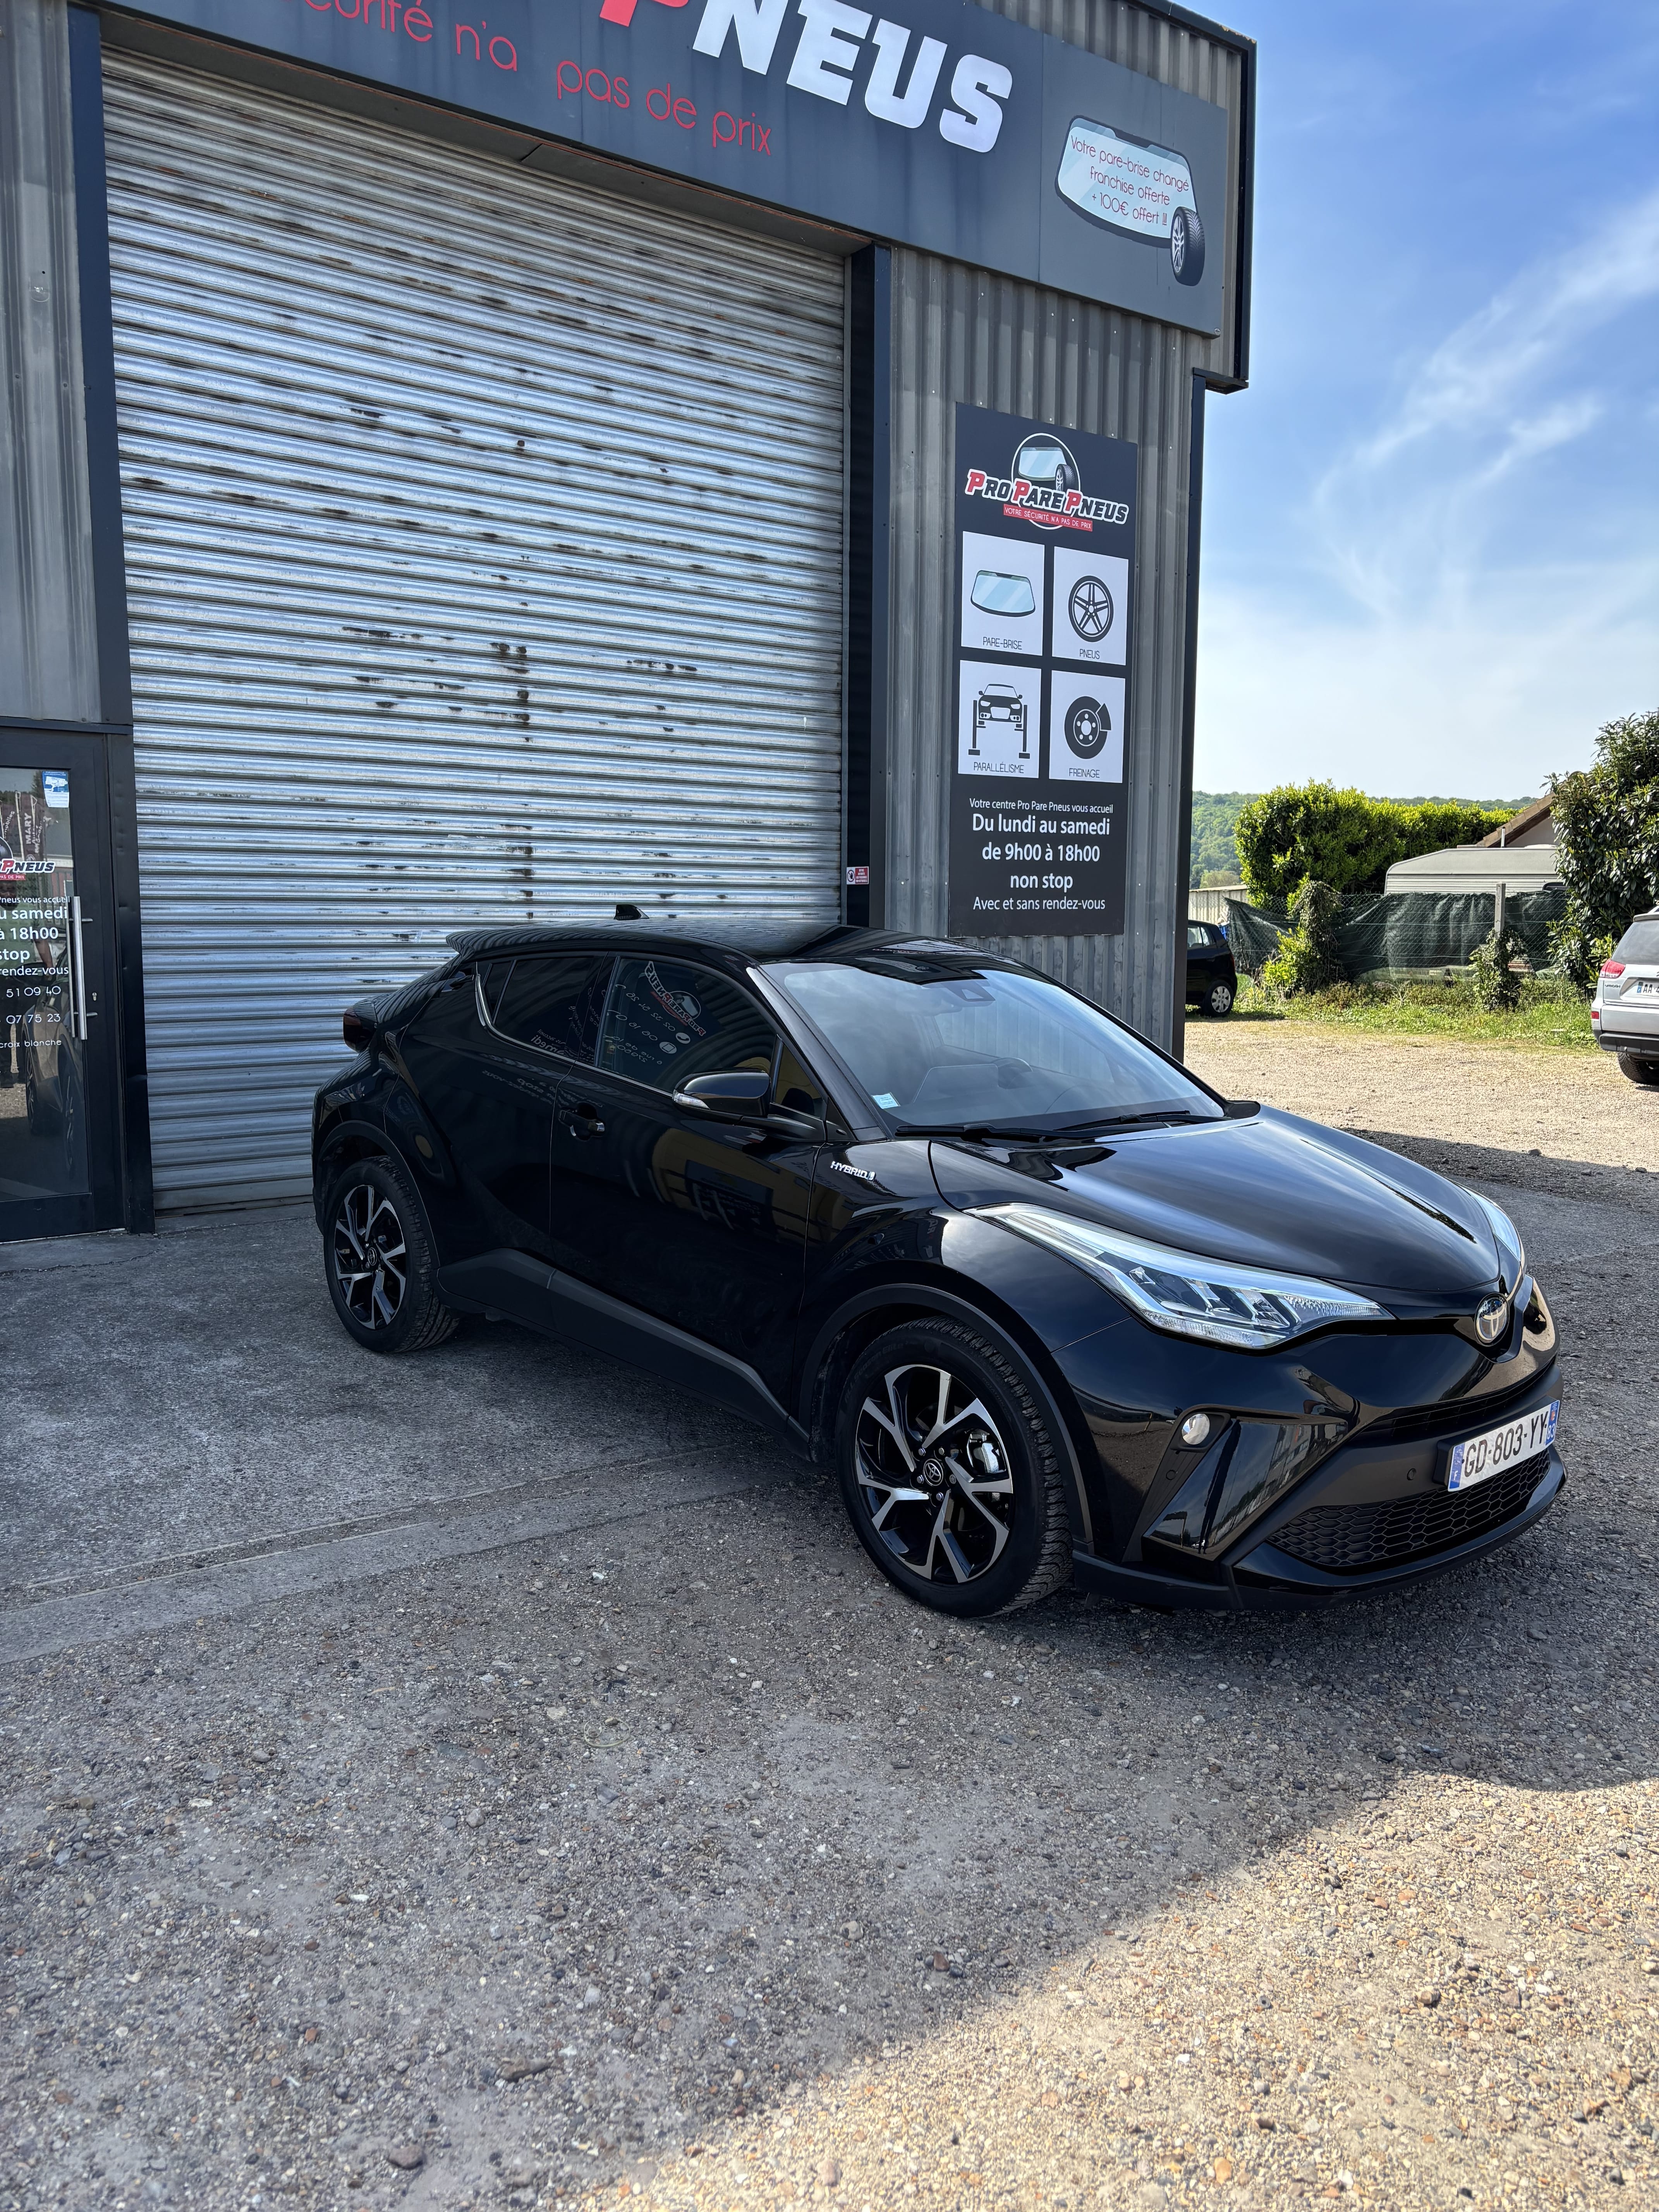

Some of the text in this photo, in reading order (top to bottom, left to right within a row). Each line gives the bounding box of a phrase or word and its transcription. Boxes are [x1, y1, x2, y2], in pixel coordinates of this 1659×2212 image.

[305, 0, 771, 155] urité n'a pas de prix
[599, 0, 1012, 153] NEUS
[1071, 135, 1189, 192] Votre pare-brise changé
[1091, 167, 1170, 205] franchise offerte
[1100, 192, 1128, 216] 100€
[1133, 208, 1159, 224] offert
[965, 470, 1128, 524] PRO PARE PNEUS
[1005, 507, 1022, 516] VOTRE
[1024, 510, 1049, 521] SÉCURITÉ
[983, 637, 1022, 650] PARE-BRISE
[1080, 649, 1099, 659] PNEUS
[974, 762, 1024, 773] PARALLÉLISME
[1069, 768, 1100, 778] FREINAGE
[970, 798, 1113, 813] Votre centre Pro Pare Pneus vous accueil
[973, 814, 1109, 835] Du lundi au samedi
[982, 842, 1100, 861] de 9h00 à 18h00
[2, 859, 55, 872] PNEUS
[1010, 873, 1073, 892] non stop
[973, 896, 1105, 910] Avec et sans rendez-vous
[12, 906, 67, 919] samedi
[10, 927, 58, 940] 18h00
[24, 987, 41, 996] 09
[46, 986, 61, 995] 40
[6, 1013, 61, 1024] 07 75 23
[830, 1161, 868, 1178] HYBRID
[1547, 1423, 1555, 1440] 83
[1464, 1411, 1548, 1477] GD-803-YY
